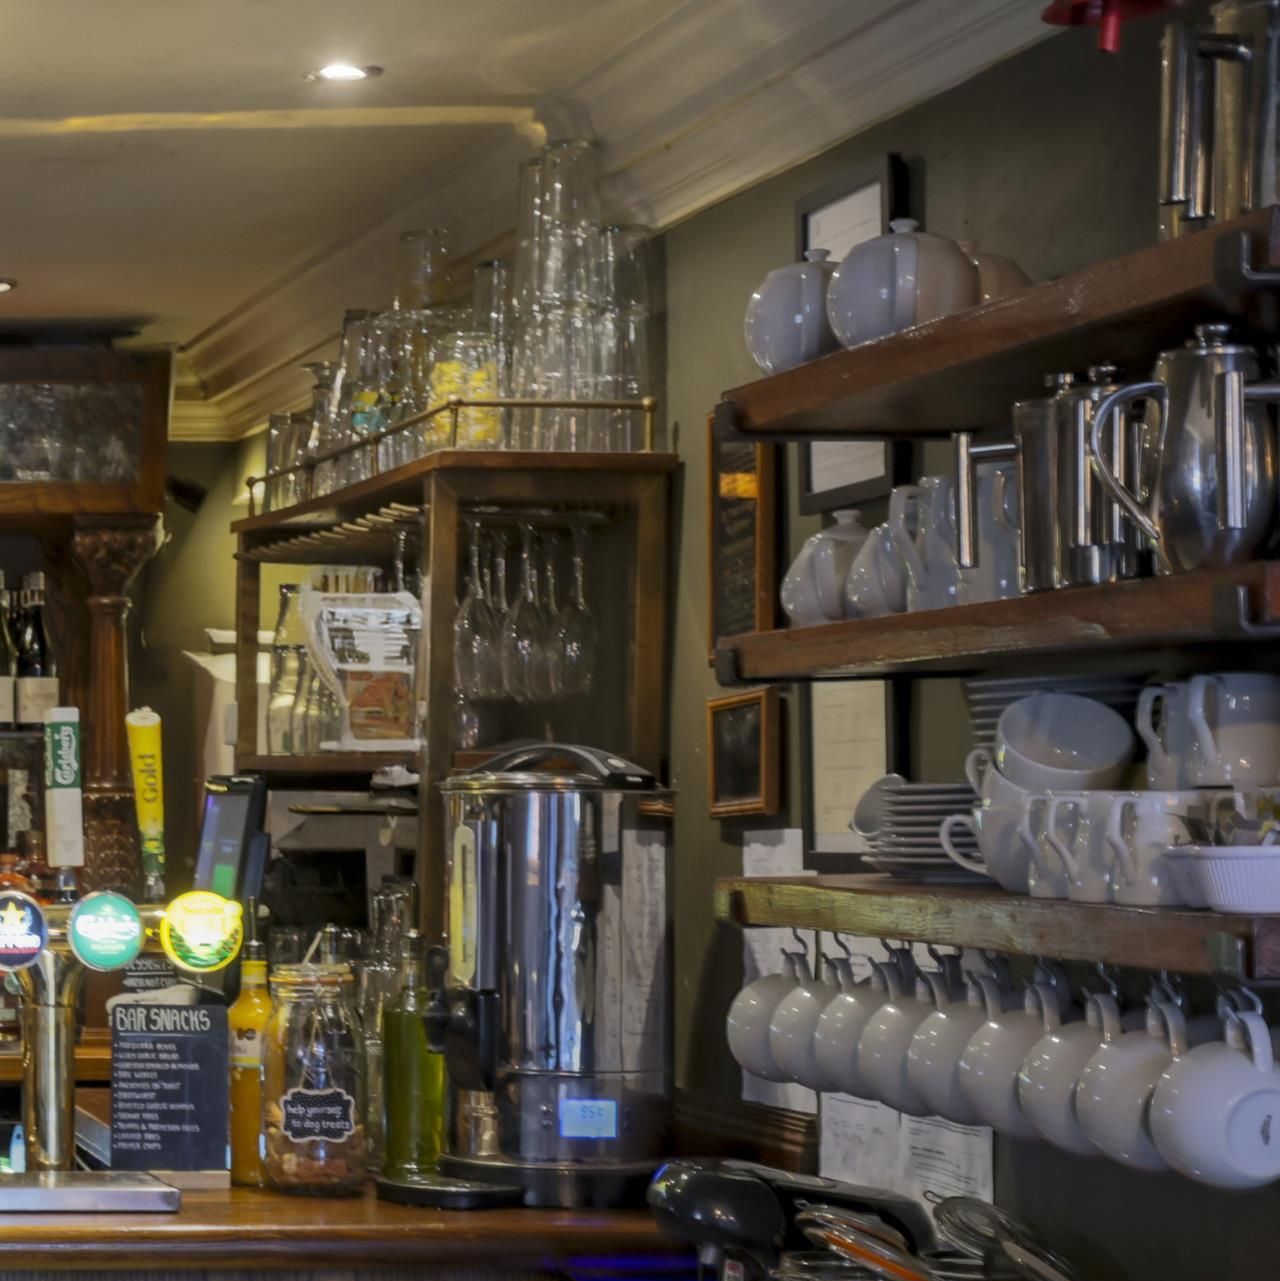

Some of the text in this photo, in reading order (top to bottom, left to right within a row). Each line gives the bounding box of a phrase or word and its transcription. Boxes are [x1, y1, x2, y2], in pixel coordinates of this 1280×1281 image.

[54, 725, 79, 785] Carlsberg
[137, 753, 159, 803] Gold
[115, 1007, 211, 1032] BAR SNACKS
[287, 1104, 342, 1119] help yourself
[291, 1119, 351, 1132] to dog treats
